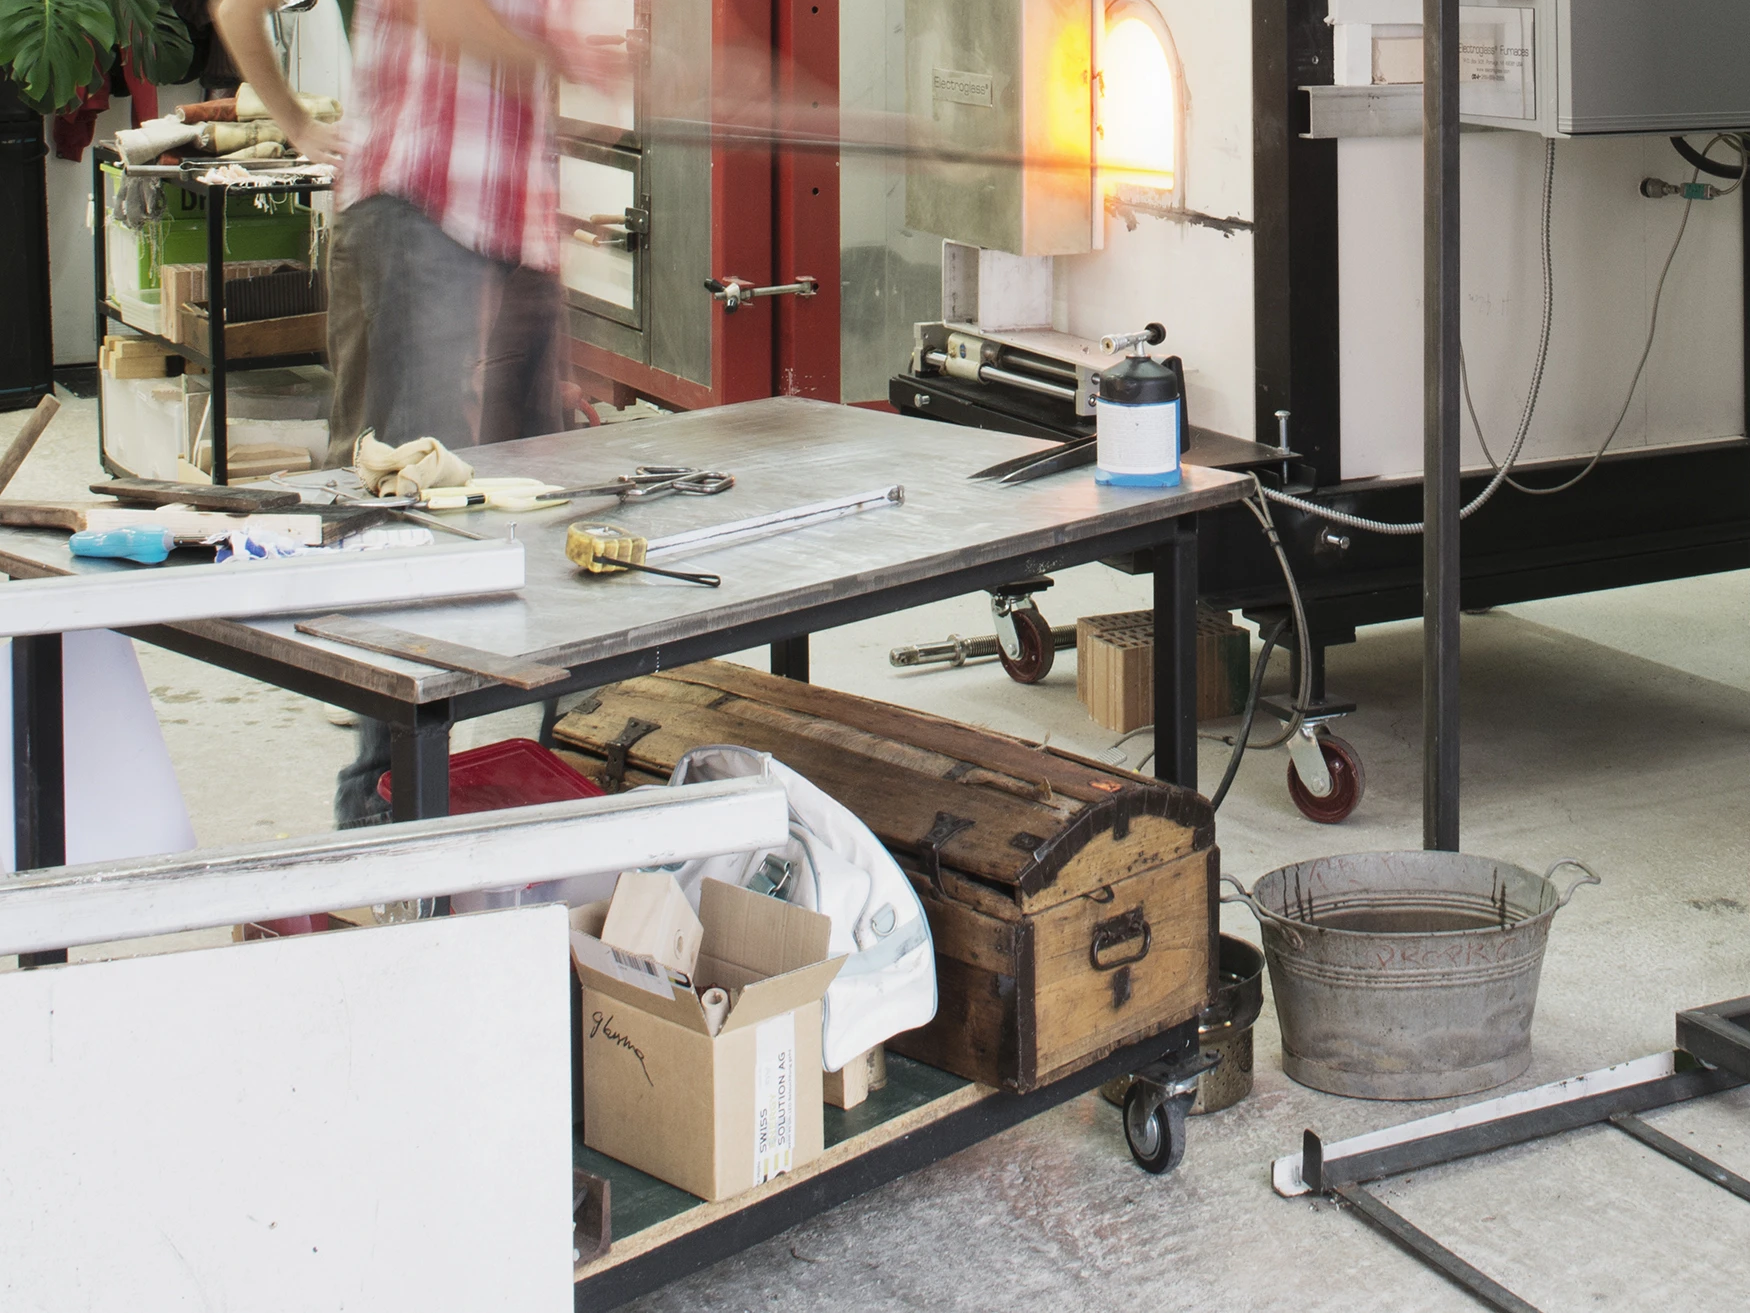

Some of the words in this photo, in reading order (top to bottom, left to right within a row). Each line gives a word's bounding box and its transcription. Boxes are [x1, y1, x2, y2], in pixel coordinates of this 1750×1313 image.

[1500, 44, 1529, 57] Furnaces
[777, 1051, 786, 1070] AG
[760, 1108, 768, 1153] SWISS
[769, 1094, 777, 1149] ENERGY
[777, 1074, 786, 1146] SOLUTION
